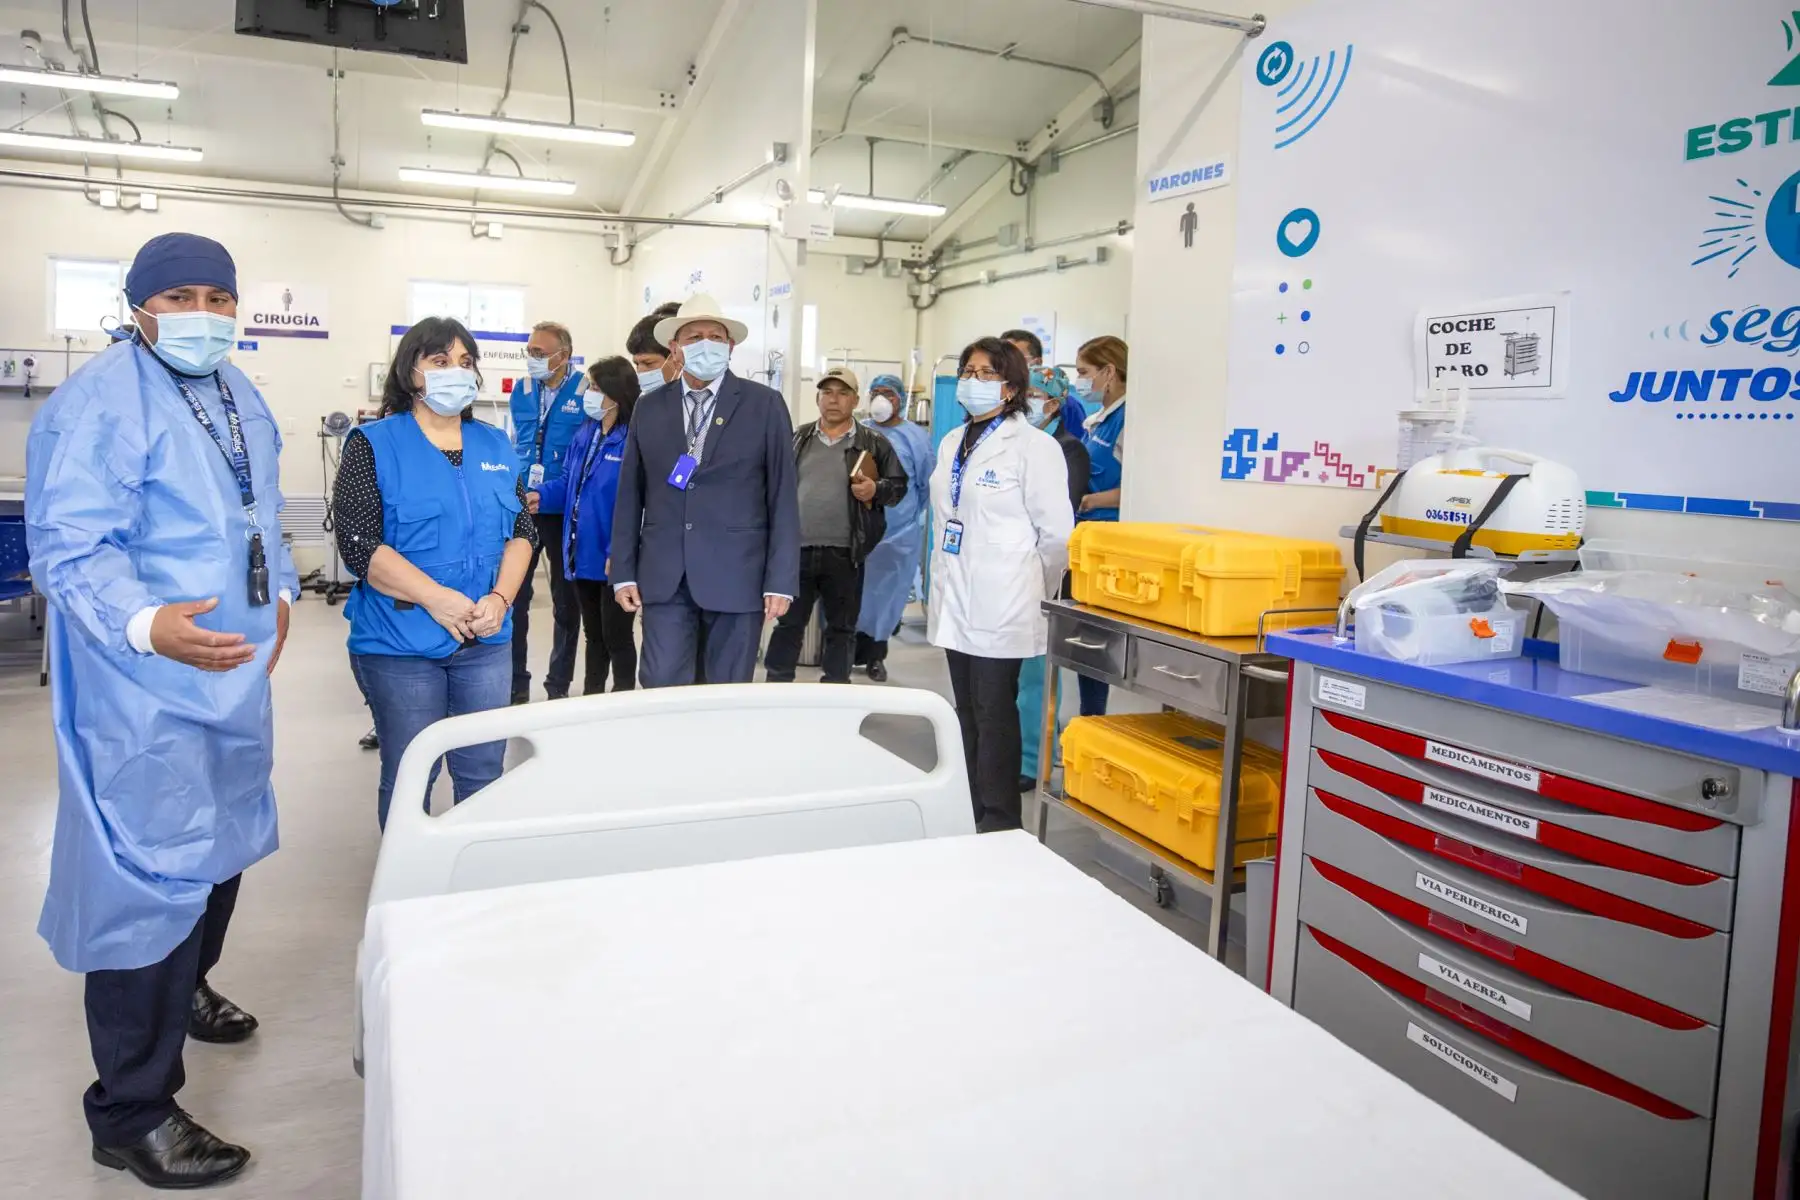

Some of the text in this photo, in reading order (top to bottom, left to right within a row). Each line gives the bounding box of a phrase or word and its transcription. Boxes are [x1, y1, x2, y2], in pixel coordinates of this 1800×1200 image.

[1685, 106, 1800, 161] EST
[1149, 162, 1225, 193] VARONES
[253, 312, 320, 326] CIRUGÍA
[1429, 317, 1496, 335] COCHE
[1445, 342, 1472, 356] DE
[1608, 366, 1800, 403] JUNTO
[1431, 745, 1532, 782] MEDICAMENTOS
[1430, 791, 1530, 829] MEDICAMENTOS
[1421, 877, 1521, 928] VIA PERIFERICA
[1439, 965, 1508, 1006] VIA AEREA
[1422, 1034, 1499, 1085] SOLUCIONES
